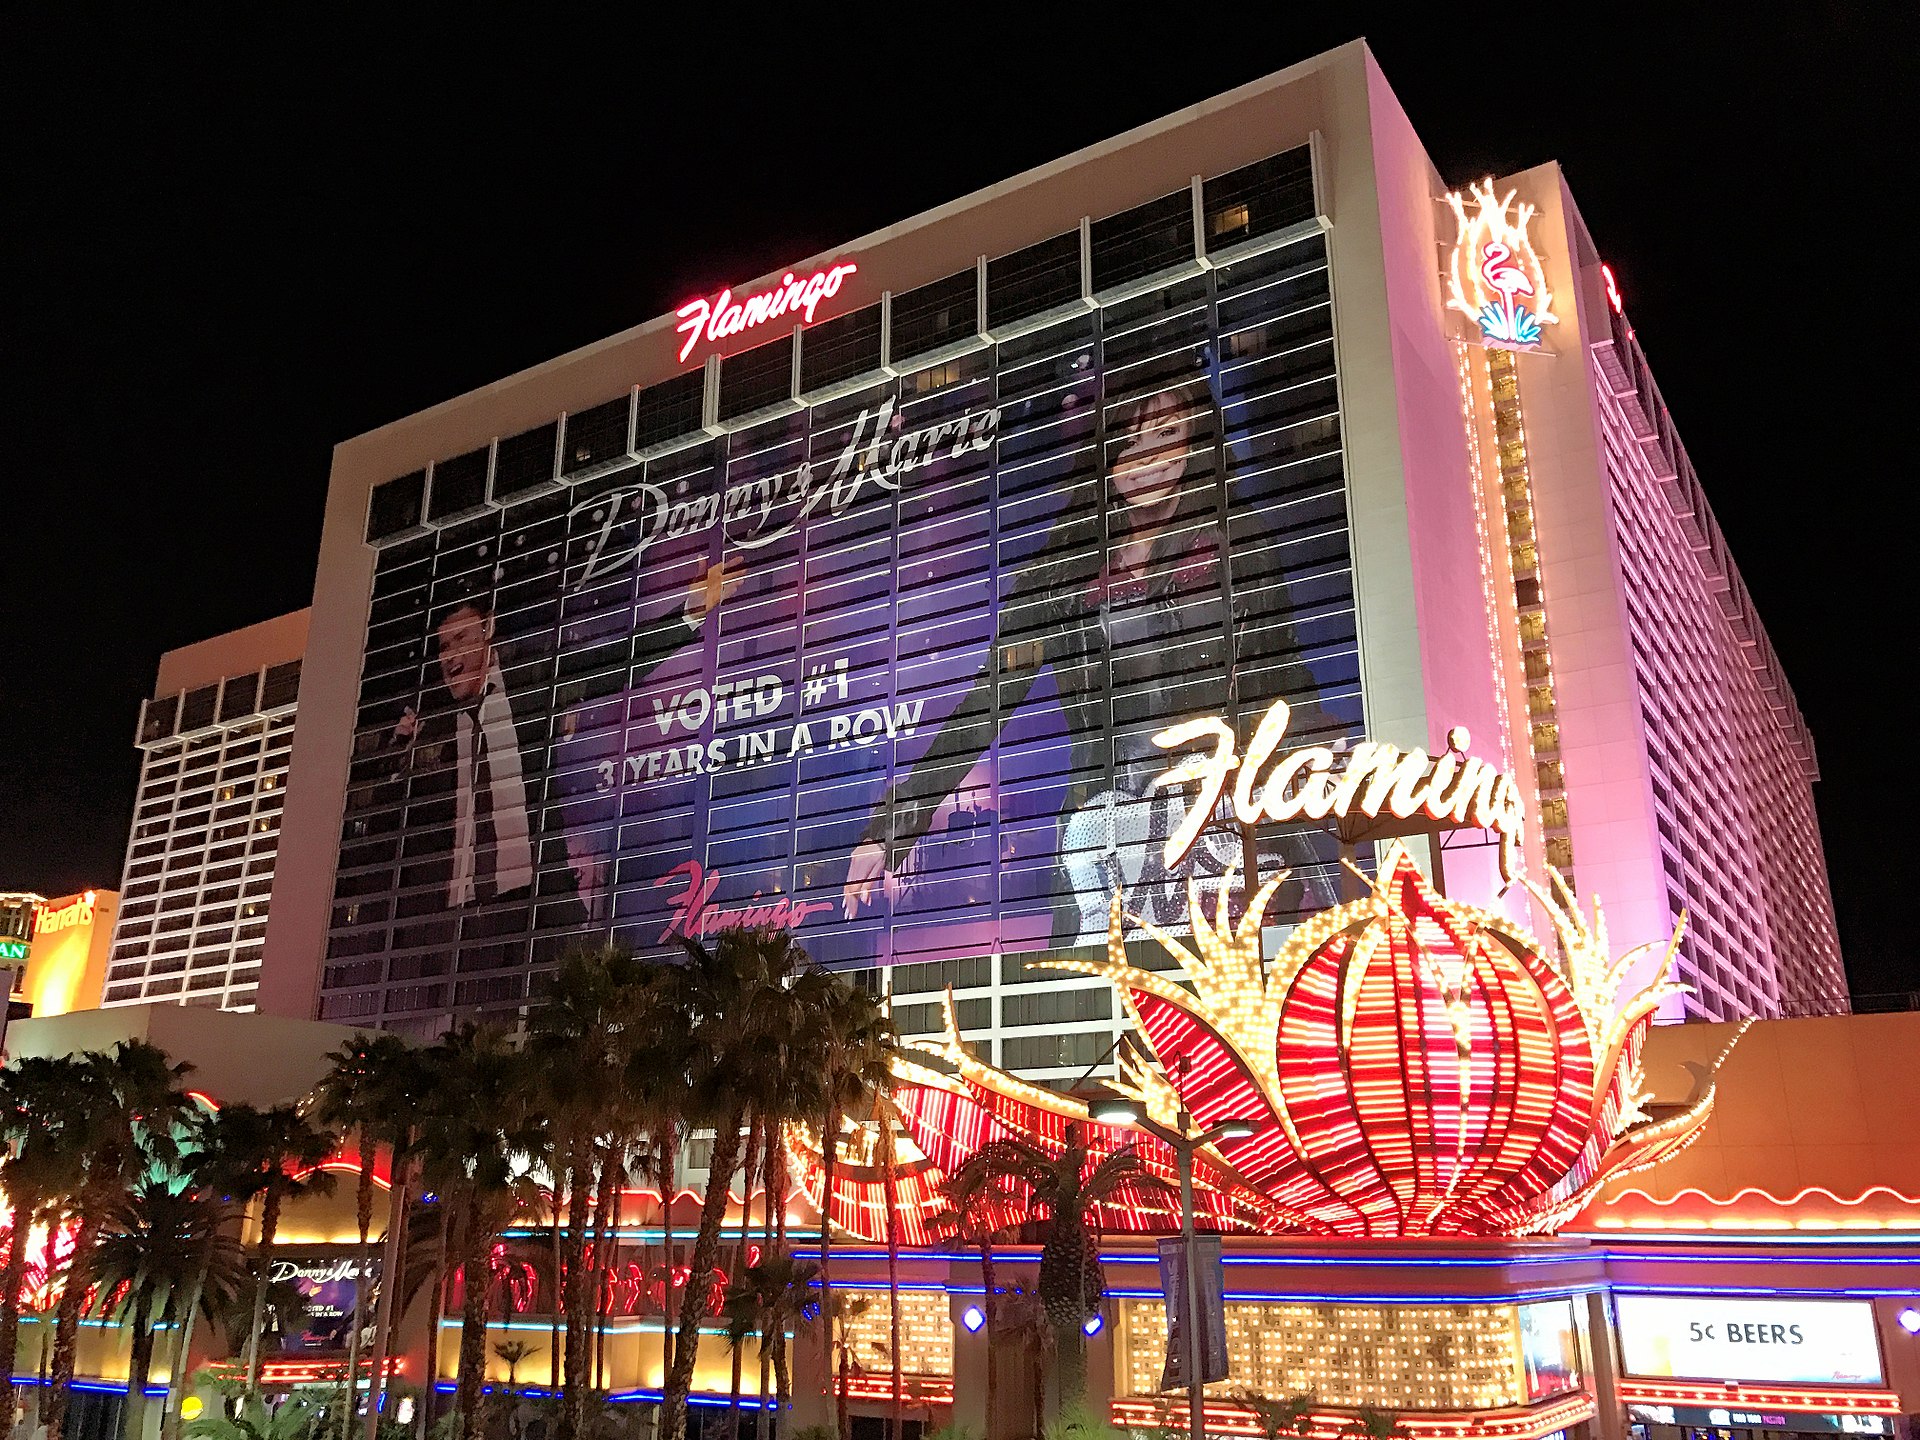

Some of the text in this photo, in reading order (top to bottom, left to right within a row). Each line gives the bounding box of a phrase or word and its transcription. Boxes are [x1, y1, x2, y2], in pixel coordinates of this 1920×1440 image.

[677, 264, 857, 363] Flamingo
[558, 472, 784, 591] Donny
[790, 395, 1001, 525] Marie
[652, 658, 849, 736] VOTED #1
[595, 701, 926, 793] 3 YEARS IN A ROW
[1151, 700, 1525, 884] Flaming
[654, 860, 834, 945] Flamingo
[1727, 1323, 1804, 1344] BEERS
